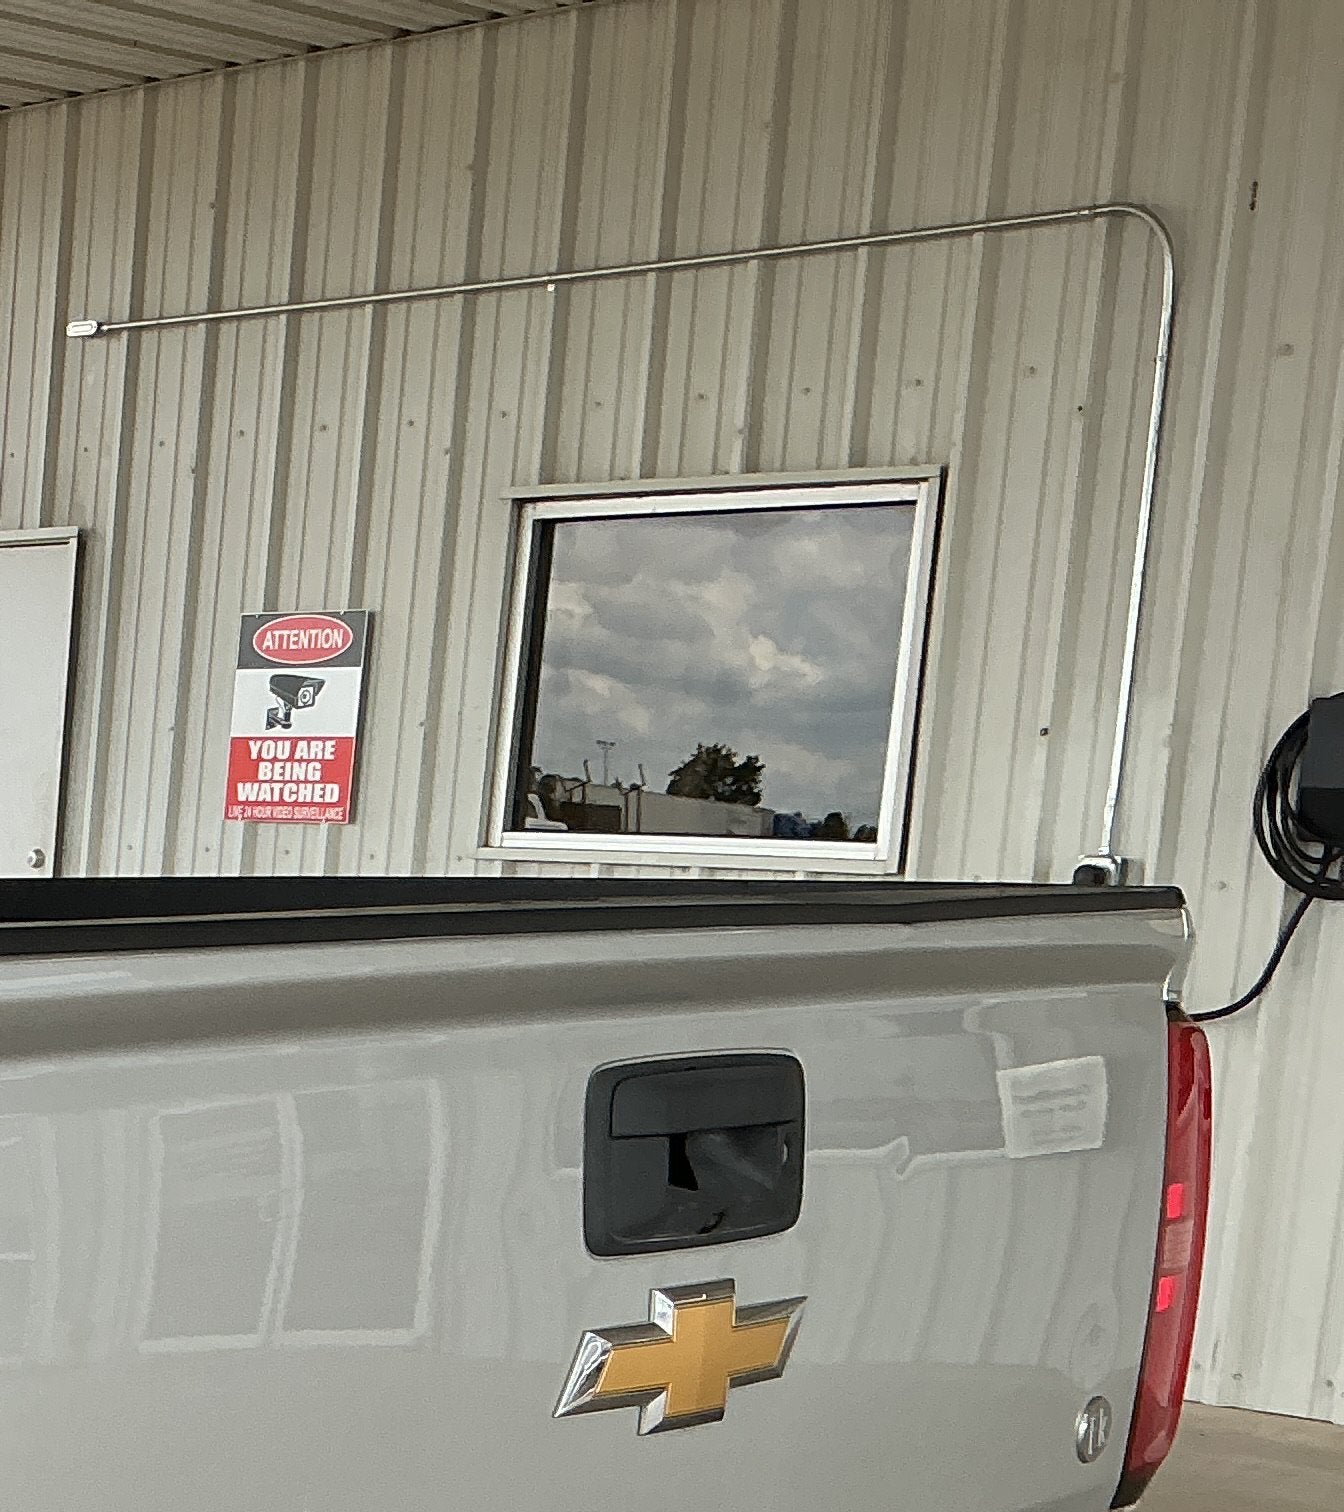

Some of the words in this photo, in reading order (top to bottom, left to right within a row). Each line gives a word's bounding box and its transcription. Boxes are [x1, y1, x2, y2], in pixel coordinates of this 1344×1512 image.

[262, 628, 344, 650] ATTENTION
[248, 740, 291, 760] YOU
[293, 740, 336, 760] ARE
[257, 761, 322, 781] BEING
[237, 782, 340, 803] WATCHED
